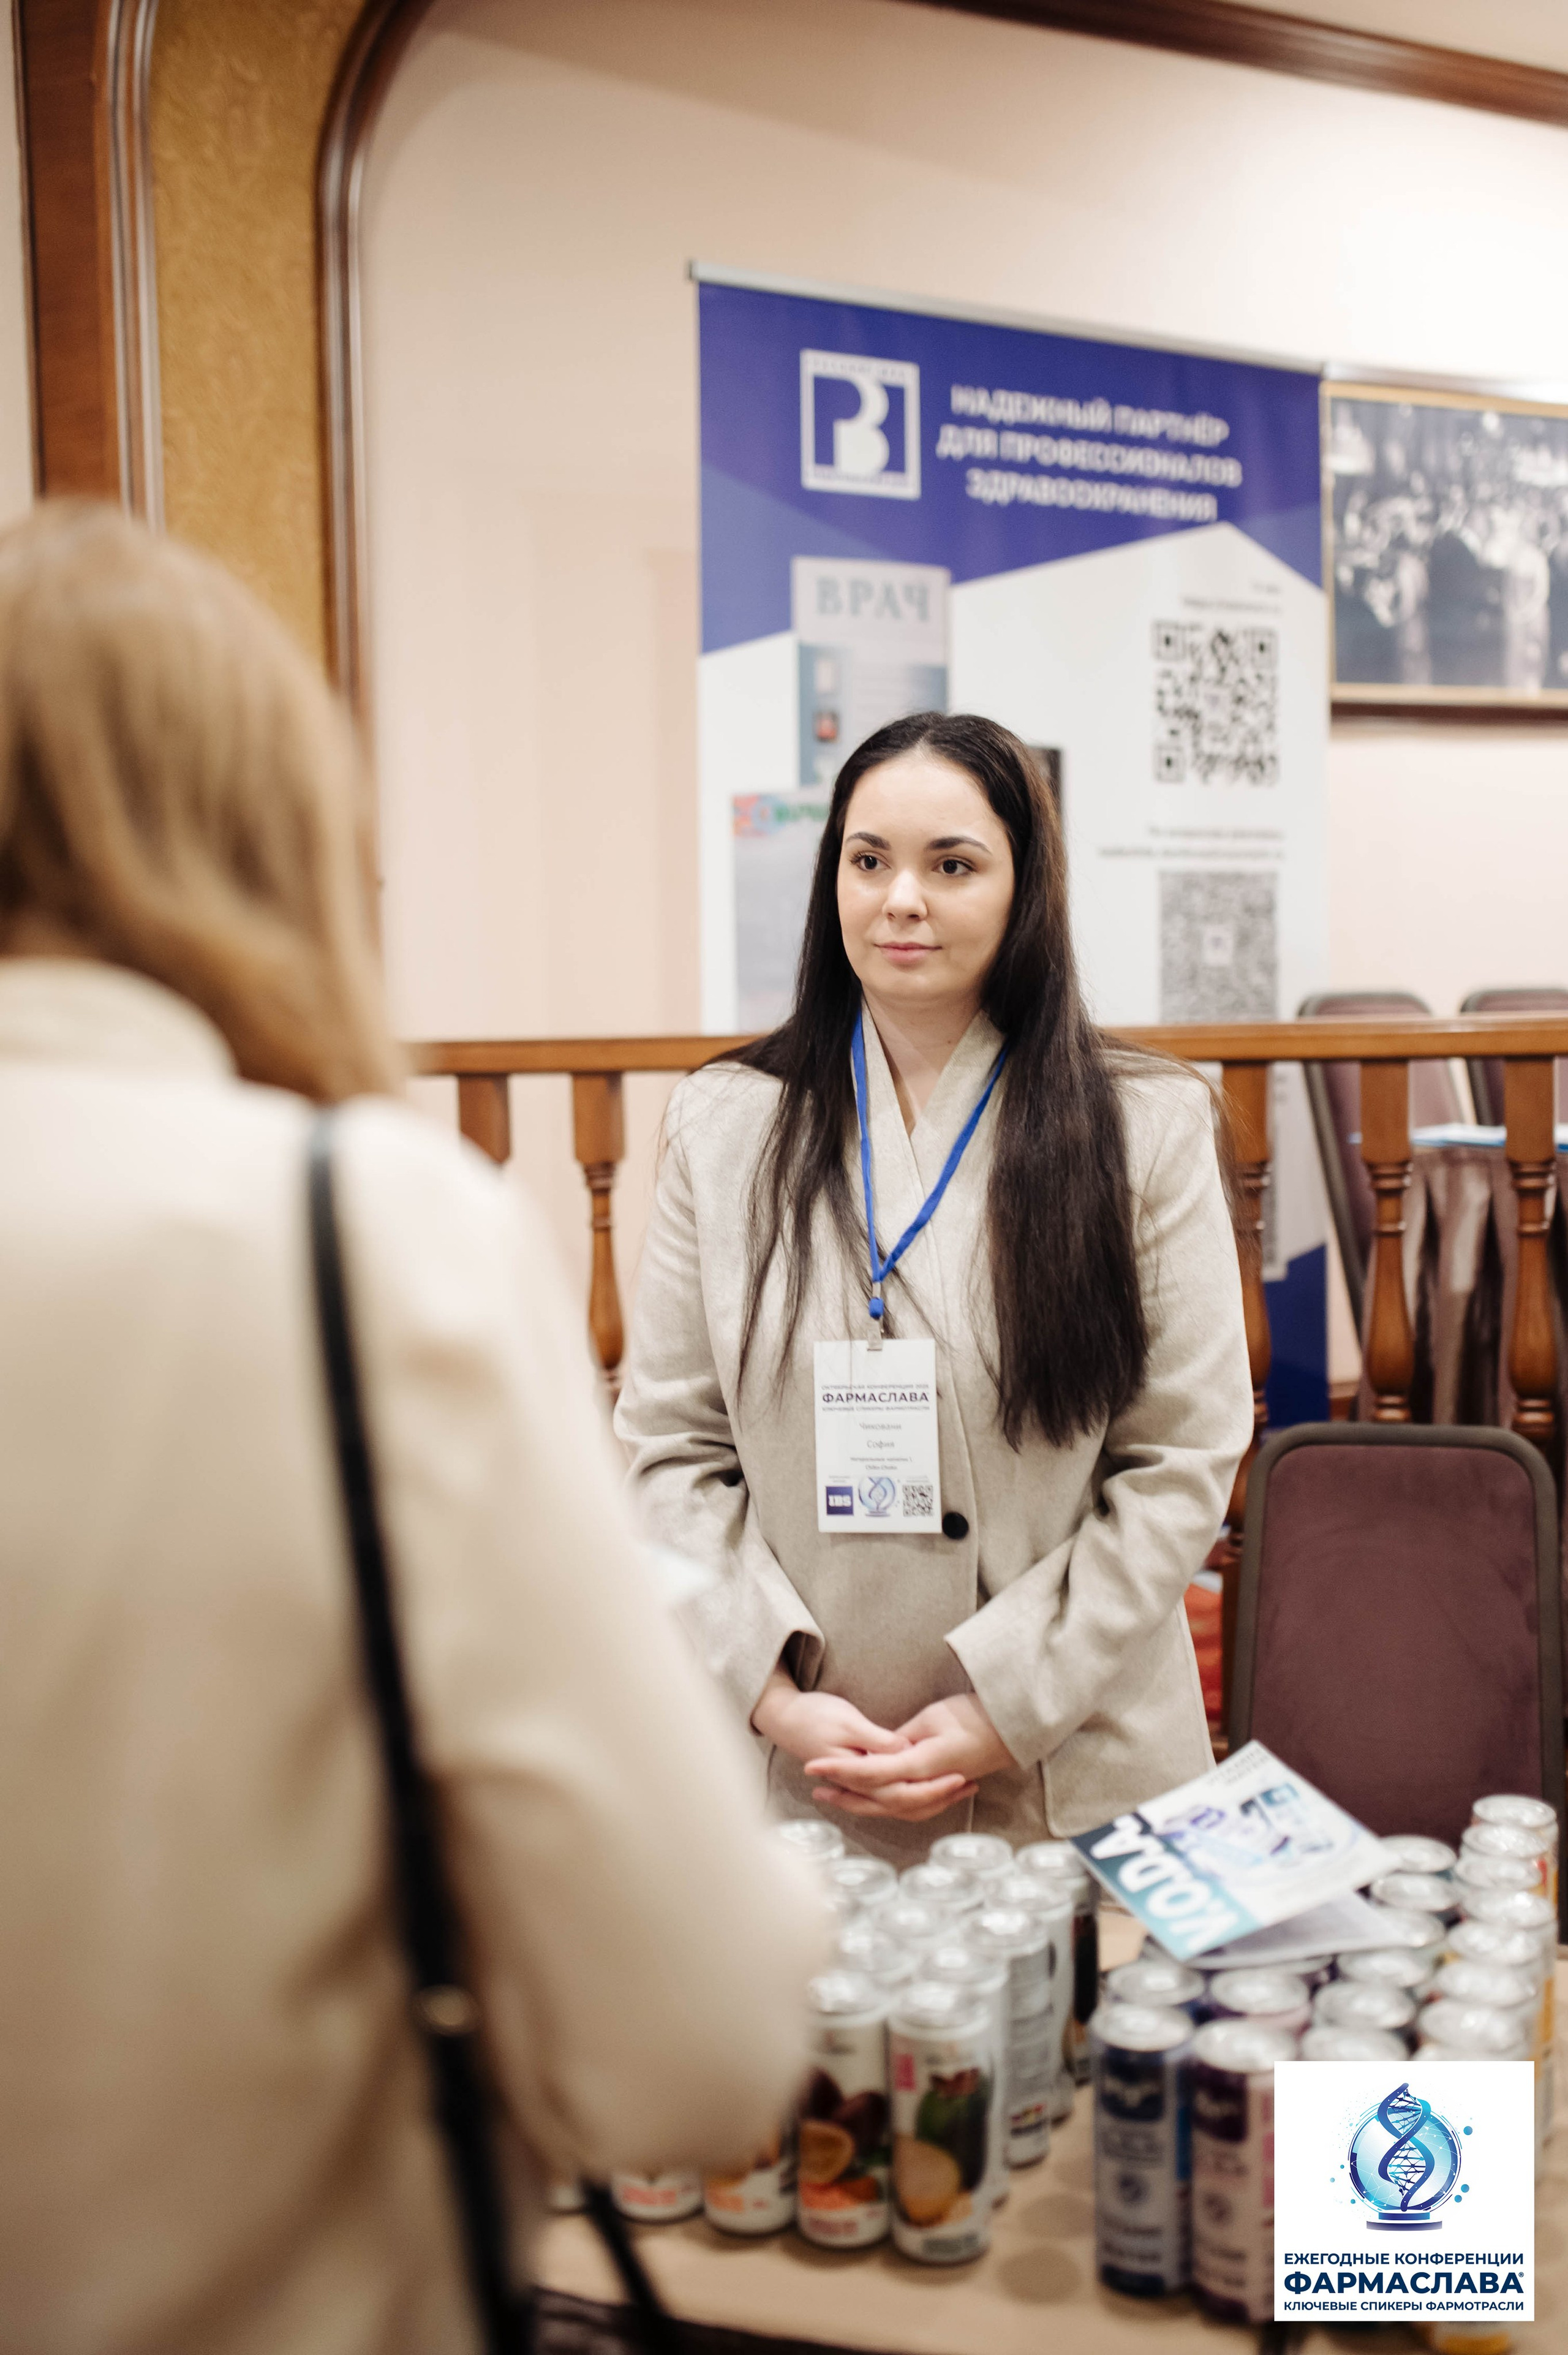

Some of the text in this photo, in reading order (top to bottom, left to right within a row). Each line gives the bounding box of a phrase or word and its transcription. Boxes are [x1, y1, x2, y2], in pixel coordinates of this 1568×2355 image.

[936, 425, 1242, 488] ДЛЯ ПРОФЕССИОНАЛОВ
[966, 467, 1217, 521] ЗДРАВООХРАНЕНИЯ
[816, 576, 930, 622] ВРАЧ
[823, 1393, 929, 1403] ФАРМАСЛАВА
[867, 1440, 895, 1449] София
